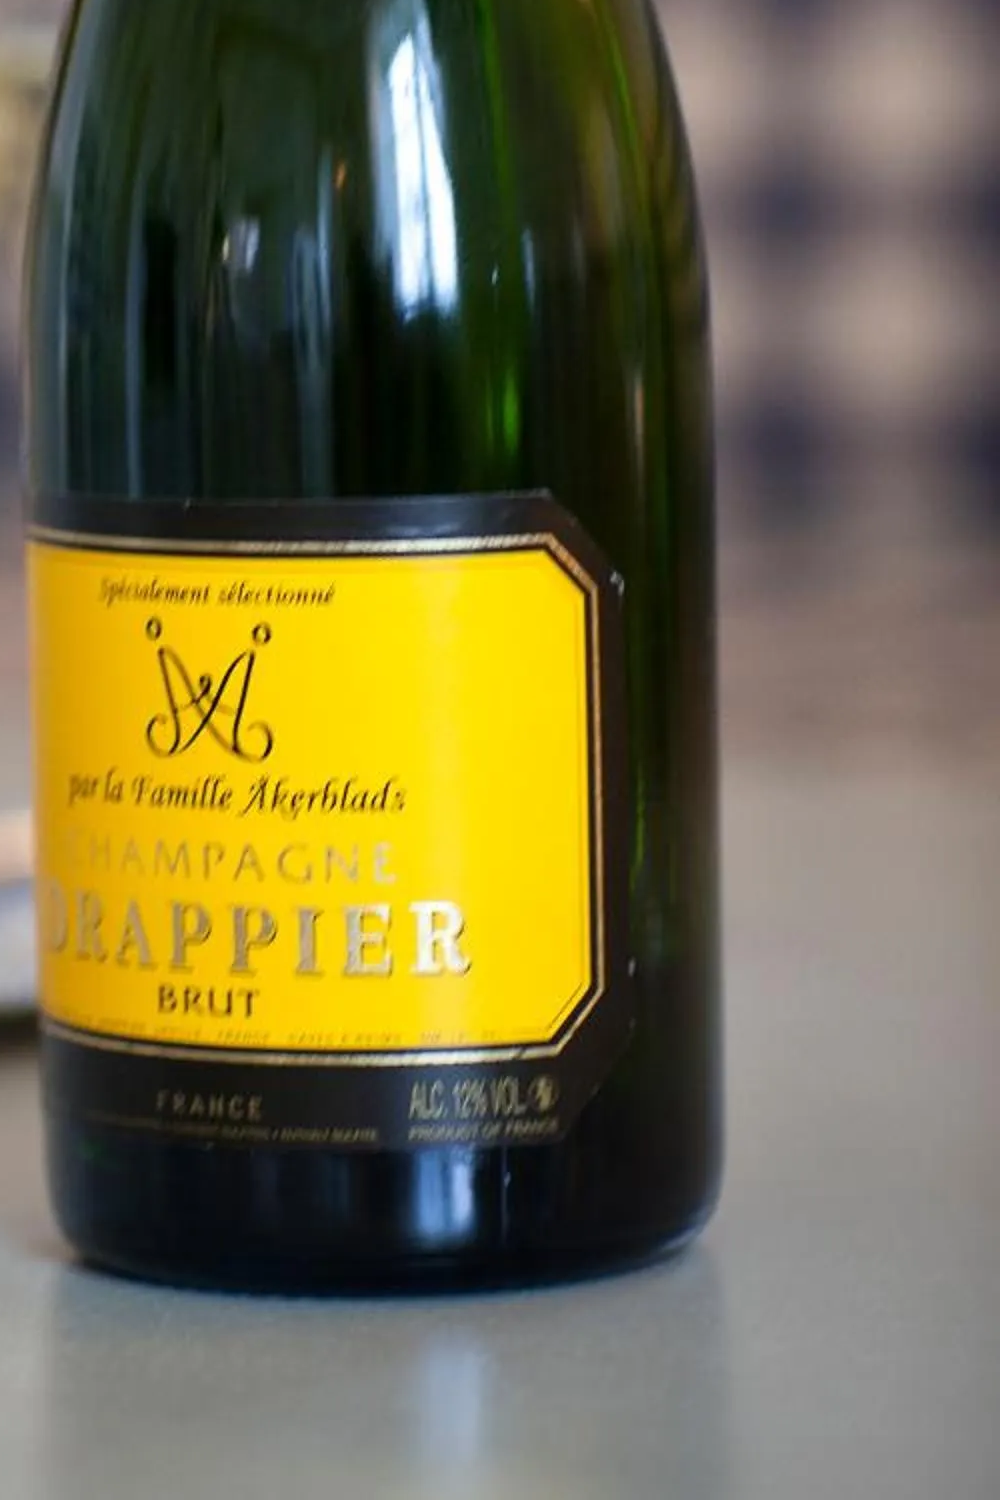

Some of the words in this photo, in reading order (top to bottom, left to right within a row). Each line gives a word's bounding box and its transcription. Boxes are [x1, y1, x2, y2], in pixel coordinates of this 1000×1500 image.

[102, 574, 210, 608] Spécialement
[218, 578, 336, 607] sélectionné
[68, 772, 99, 809] par
[104, 765, 125, 804] la
[130, 772, 234, 811] Famille
[42, 876, 473, 978] DRAPPIER
[155, 983, 260, 1018] BRUT
[155, 1088, 264, 1121] FRANCE
